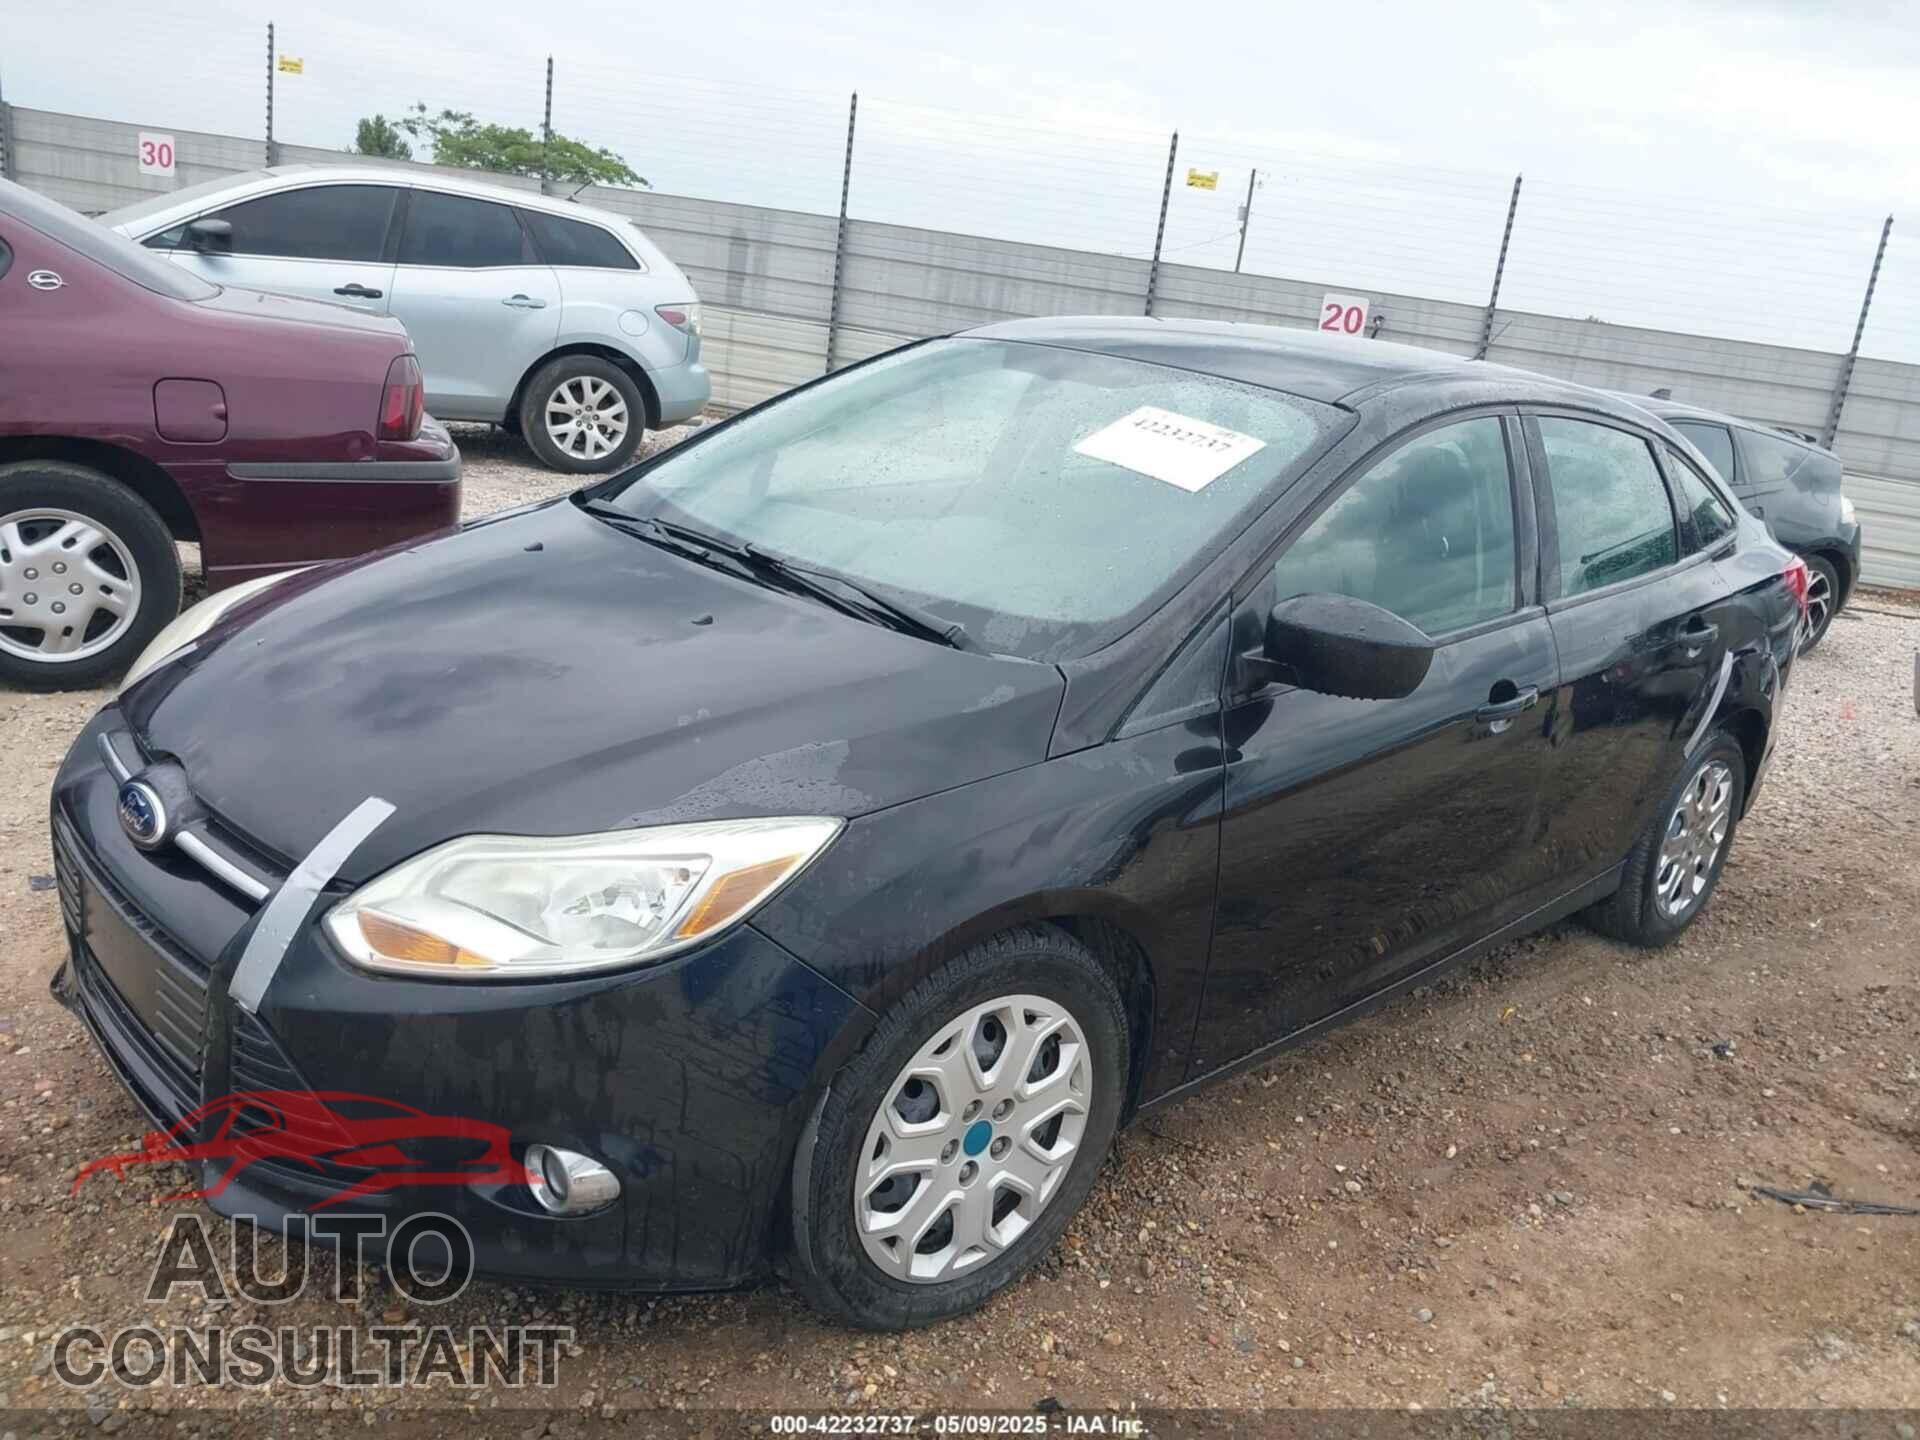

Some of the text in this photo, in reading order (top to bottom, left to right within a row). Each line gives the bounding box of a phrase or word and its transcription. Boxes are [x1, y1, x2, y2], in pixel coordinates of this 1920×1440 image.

[142, 141, 172, 168] 30
[1321, 303, 1363, 334] 20
[120, 791, 149, 831] Ford
